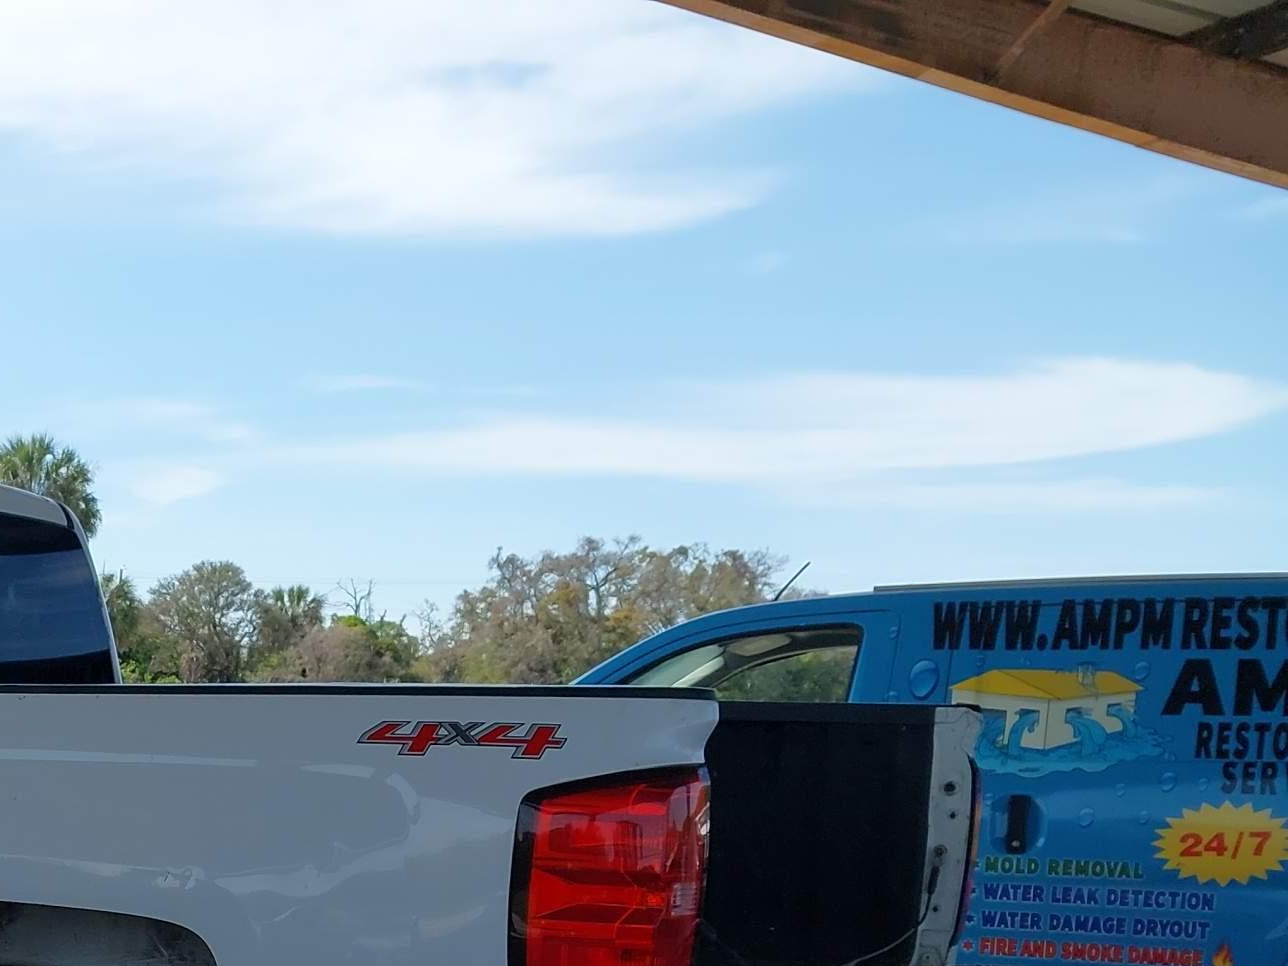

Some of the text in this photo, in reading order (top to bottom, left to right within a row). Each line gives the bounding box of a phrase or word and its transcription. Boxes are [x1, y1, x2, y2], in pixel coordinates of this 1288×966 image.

[933, 596, 1288, 651] WWW.AMPMREST
[1221, 761, 1288, 795] SER
[1179, 831, 1272, 860] 24/7
[983, 856, 1145, 880] MOLD REMOVAL
[983, 883, 1215, 912] WATER LEAK DETECTION
[981, 910, 1211, 940] WATER DAMAGE DRYOUT
[979, 936, 1017, 957] FIRE
[1020, 939, 1056, 959] AND
[1061, 941, 1123, 963] SMOKE
